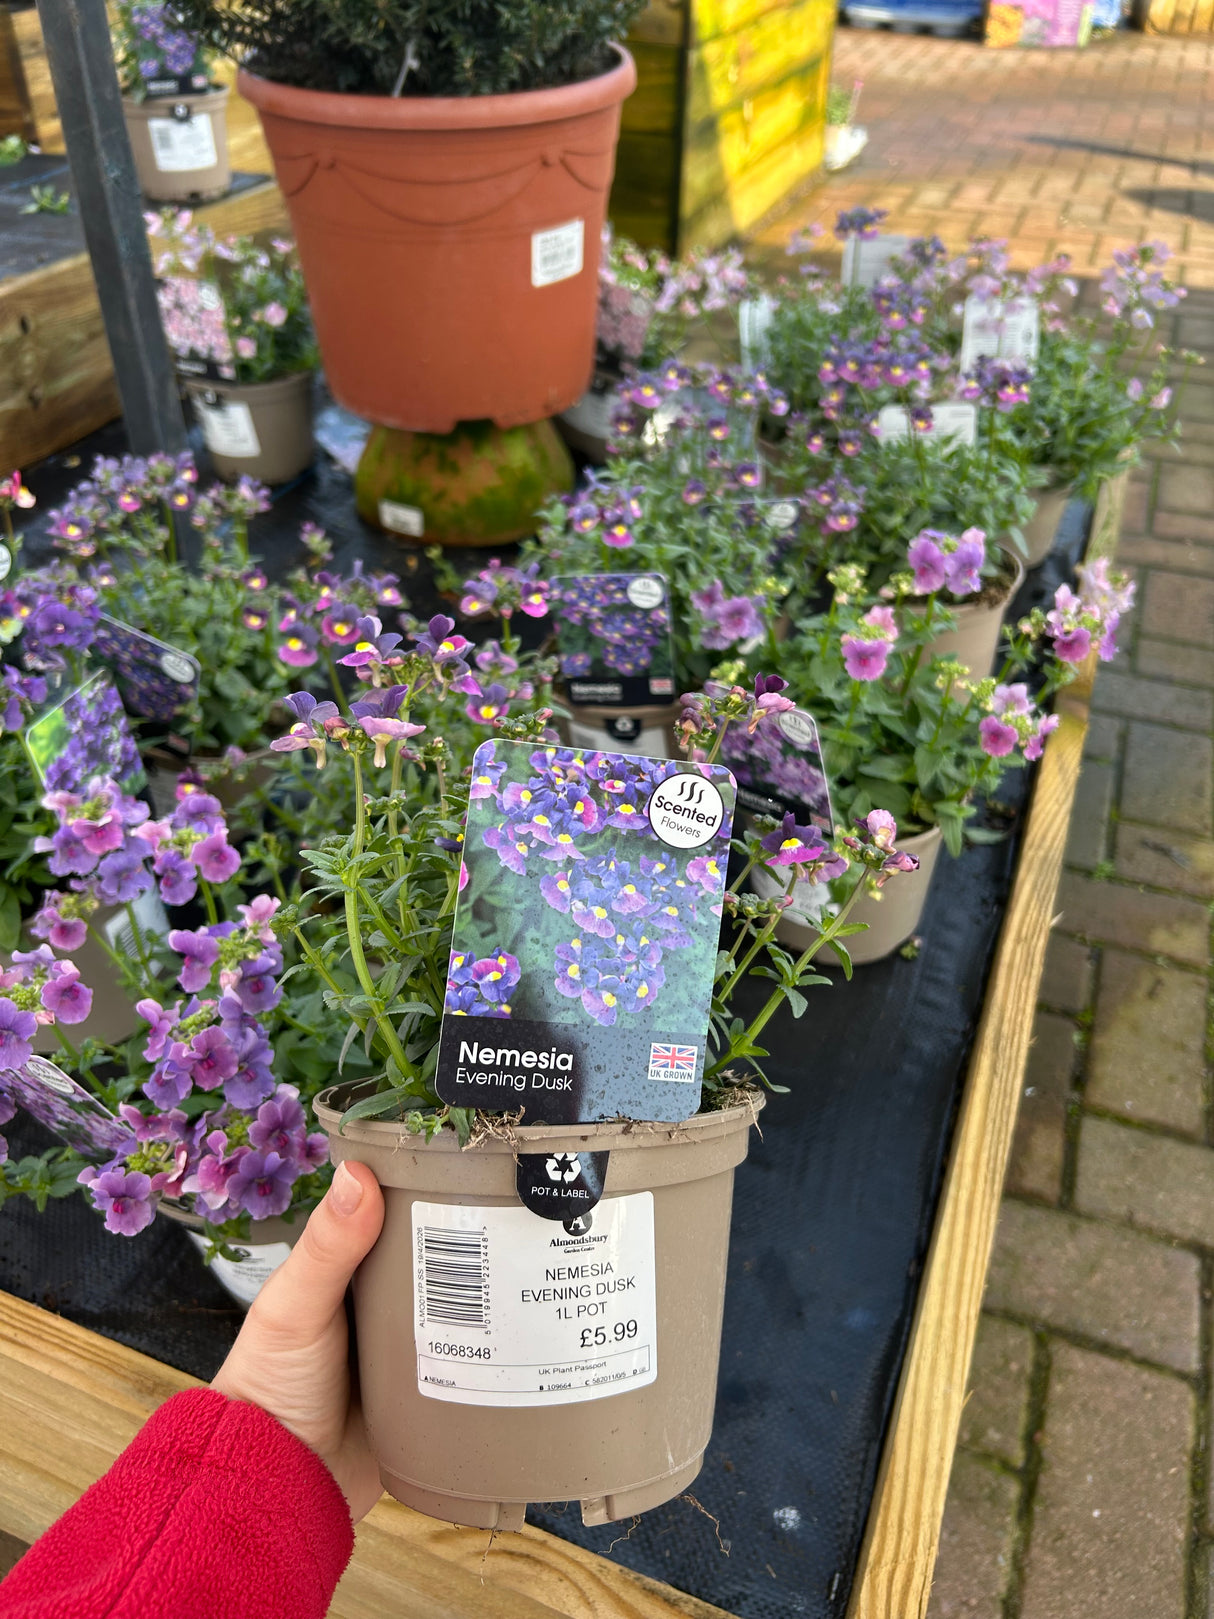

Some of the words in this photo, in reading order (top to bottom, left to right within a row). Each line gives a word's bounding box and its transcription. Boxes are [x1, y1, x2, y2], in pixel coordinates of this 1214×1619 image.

[655, 795, 717, 827] Scented
[660, 815, 701, 839] Flowers
[459, 1041, 573, 1071] Nemesia
[456, 1067, 526, 1091] Evening
[531, 1073, 573, 1091] Dusk
[650, 1069, 661, 1078] UK
[663, 1070, 693, 1080] GROWN
[531, 1186, 550, 1196] POT
[552, 1188, 559, 1197] &
[561, 1189, 590, 1199] LABEL
[549, 1234, 608, 1248] Almondsbury
[417, 1268, 425, 1281] SS
[545, 1261, 614, 1282] NEMESIA
[521, 1284, 592, 1303] EVENING
[596, 1276, 636, 1296] DUSK
[556, 1306, 573, 1320] 1L
[577, 1301, 608, 1318] POT
[580, 1319, 638, 1348] £5.99
[428, 1341, 492, 1360] 16068348
[538, 1368, 551, 1376] UK
[552, 1365, 573, 1375] Plant
[574, 1361, 607, 1372] Passport
